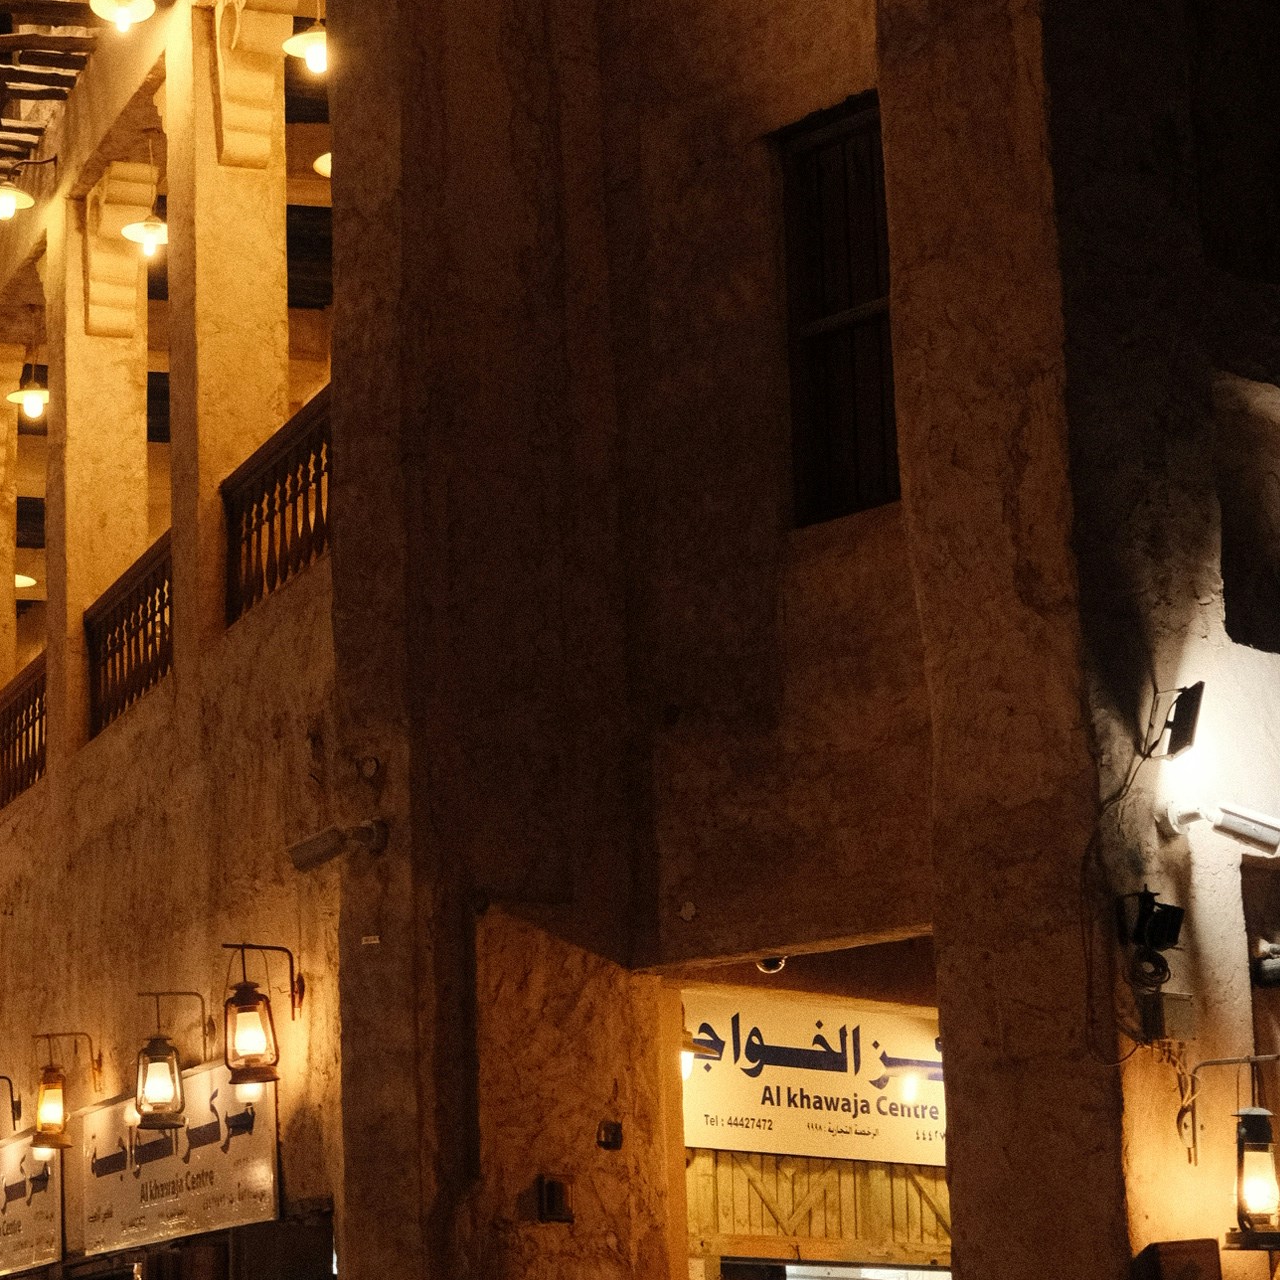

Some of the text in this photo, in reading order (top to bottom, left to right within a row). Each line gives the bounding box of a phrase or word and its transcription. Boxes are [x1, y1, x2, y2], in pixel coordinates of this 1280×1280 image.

[692, 1011, 861, 1079] الخواج
[761, 1084, 939, 1121] Al khawaja Centre
[727, 1116, 773, 1131] 44427472
